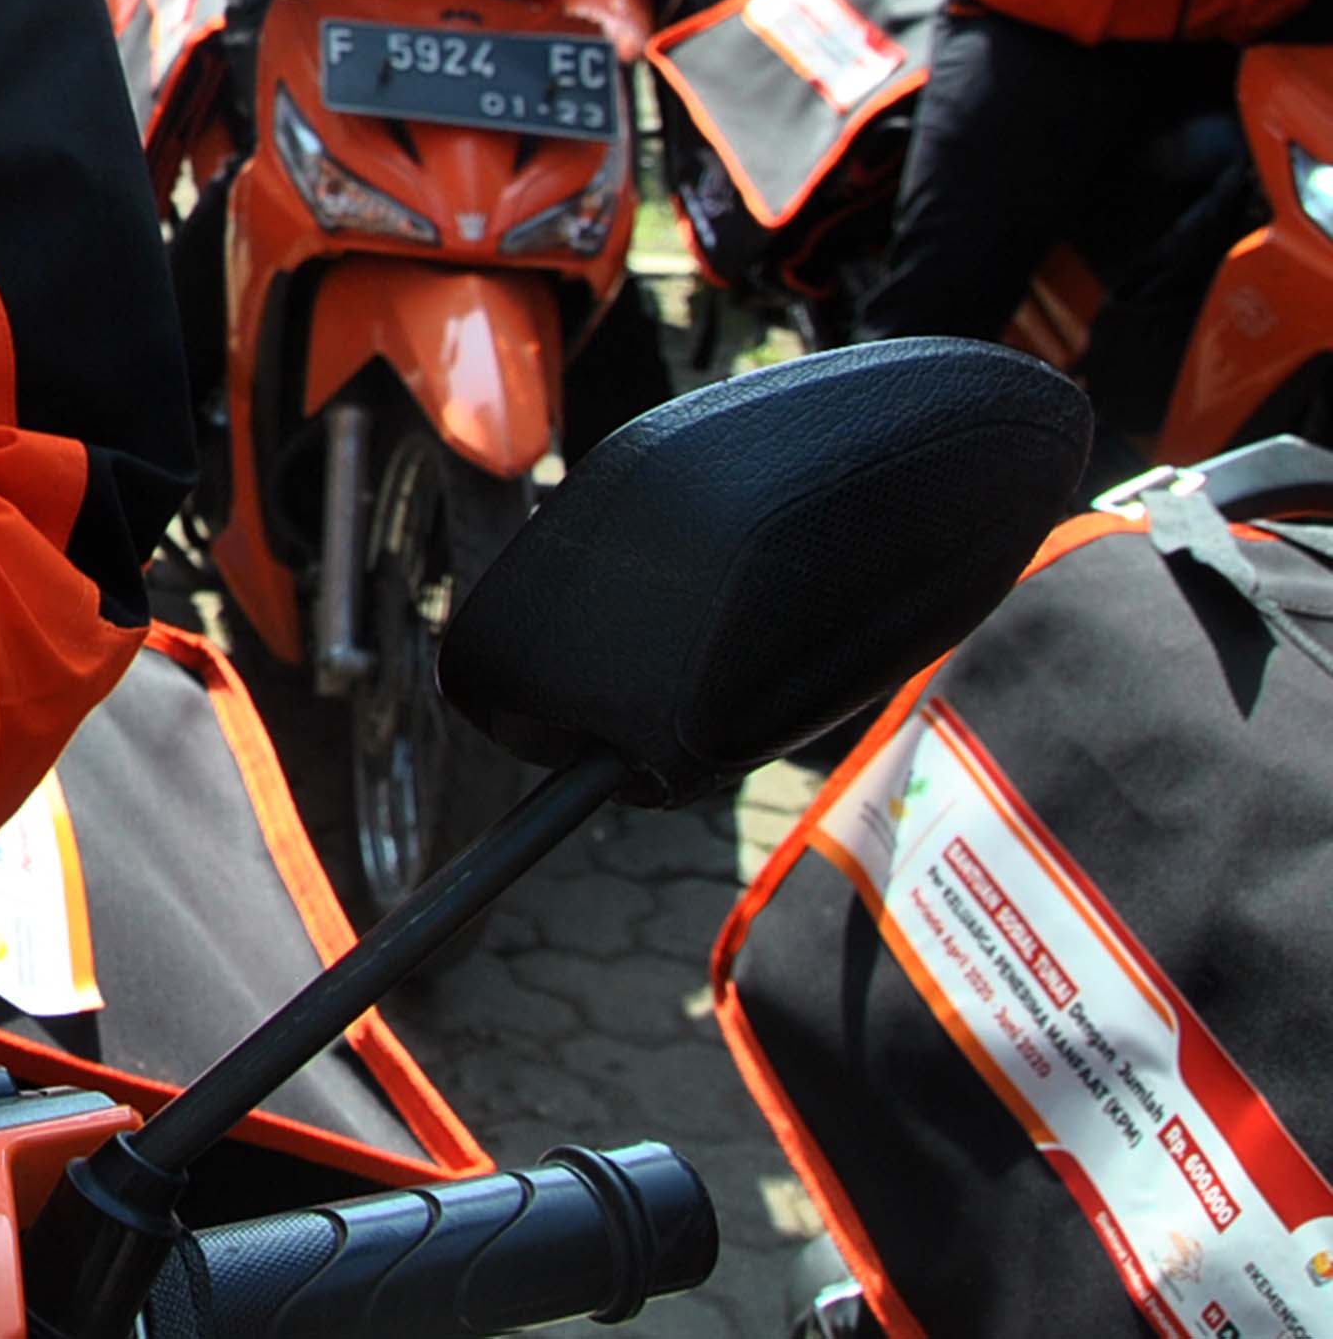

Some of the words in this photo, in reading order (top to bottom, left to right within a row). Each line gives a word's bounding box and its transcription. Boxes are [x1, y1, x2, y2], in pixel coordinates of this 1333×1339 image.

[327, 27, 353, 64] F
[386, 32, 496, 79] 5924
[548, 44, 606, 89] EC
[1016, 1031, 1052, 1079] 2020
[1046, 1022, 1109, 1101] MANFAAT
[1102, 1096, 1143, 1149] (KPM)
[1068, 1002, 1116, 1062] Dengan
[1117, 1061, 1165, 1124] Jumlah
[1164, 1124, 1187, 1161] Rp.
[1184, 1153, 1234, 1226] 600.000
[1244, 1261, 1312, 1339] #KEMENSO
